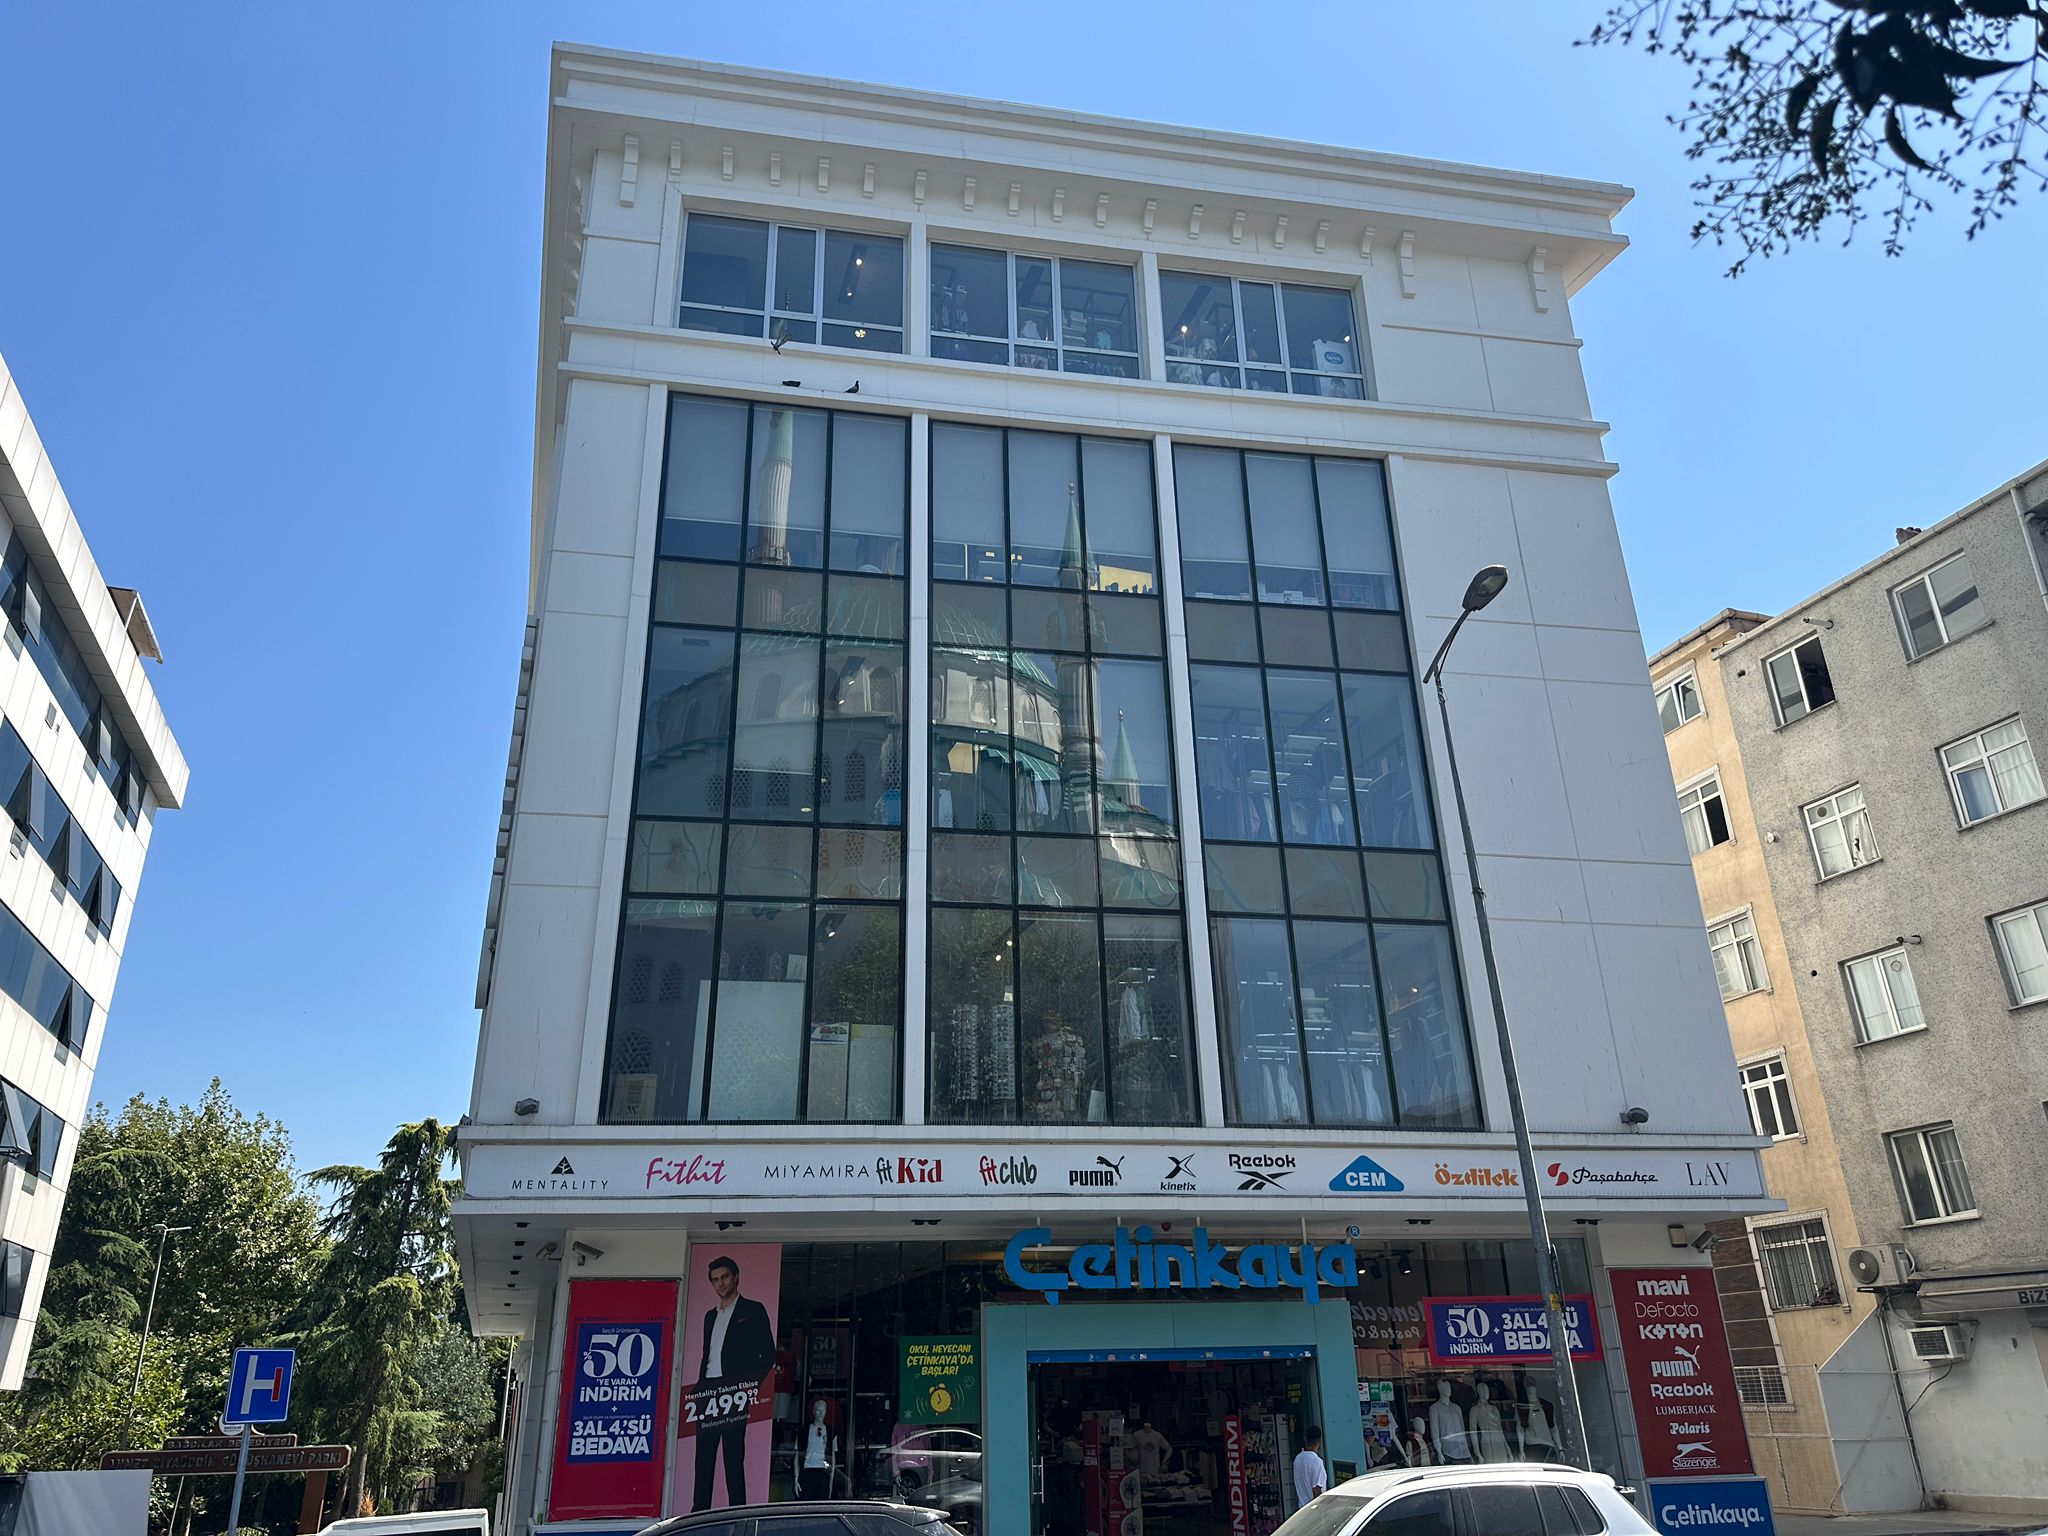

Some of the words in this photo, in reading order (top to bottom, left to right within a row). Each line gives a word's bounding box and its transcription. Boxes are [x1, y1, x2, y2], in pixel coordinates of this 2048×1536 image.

[1228, 1154, 1296, 1169] Reebok
[896, 1157, 944, 1184] Kid
[1069, 1170, 1114, 1187] PUMA
[1434, 1162, 1520, 1187] Özdilek
[1572, 1167, 1658, 1185] Paşabahçe
[1685, 1162, 1729, 1186] LAV
[512, 1180, 608, 1190] MENTALITY
[1160, 1181, 1197, 1191] kinetix
[1345, 1172, 1386, 1187] CEM
[1004, 1225, 1358, 1305] Çetinkaya
[1637, 1275, 1689, 1296] mavi
[1634, 1302, 1698, 1318] DeFacto
[1504, 1330, 1584, 1351] BEDA
[583, 1332, 655, 1378] %50
[909, 1345, 929, 1354] OKUL
[932, 1344, 971, 1353] HEYECANI
[906, 1354, 974, 1368] ÇETİNKAYA'DA
[1651, 1361, 1694, 1377] PUMA
[921, 1365, 959, 1377] BAŞLAR!
[685, 1389, 717, 1401] Mentality
[738, 1380, 759, 1389] Elbise
[1650, 1383, 1714, 1399] Reebok
[685, 1391, 748, 1423] 2.499
[747, 1389, 758, 1397] 99
[749, 1397, 759, 1405] TL
[1655, 1404, 1717, 1415] LUMBERJACK
[1669, 1421, 1710, 1434] Polaris
[228, 1437, 291, 1448] BEEDİYESİ
[570, 1436, 650, 1456] BEDAVA
[222, 1451, 304, 1467] GÜÜŞHANEVİ
[1672, 1456, 1719, 1469] Slazenger
[1661, 1503, 1765, 1528] Çetinkaya
